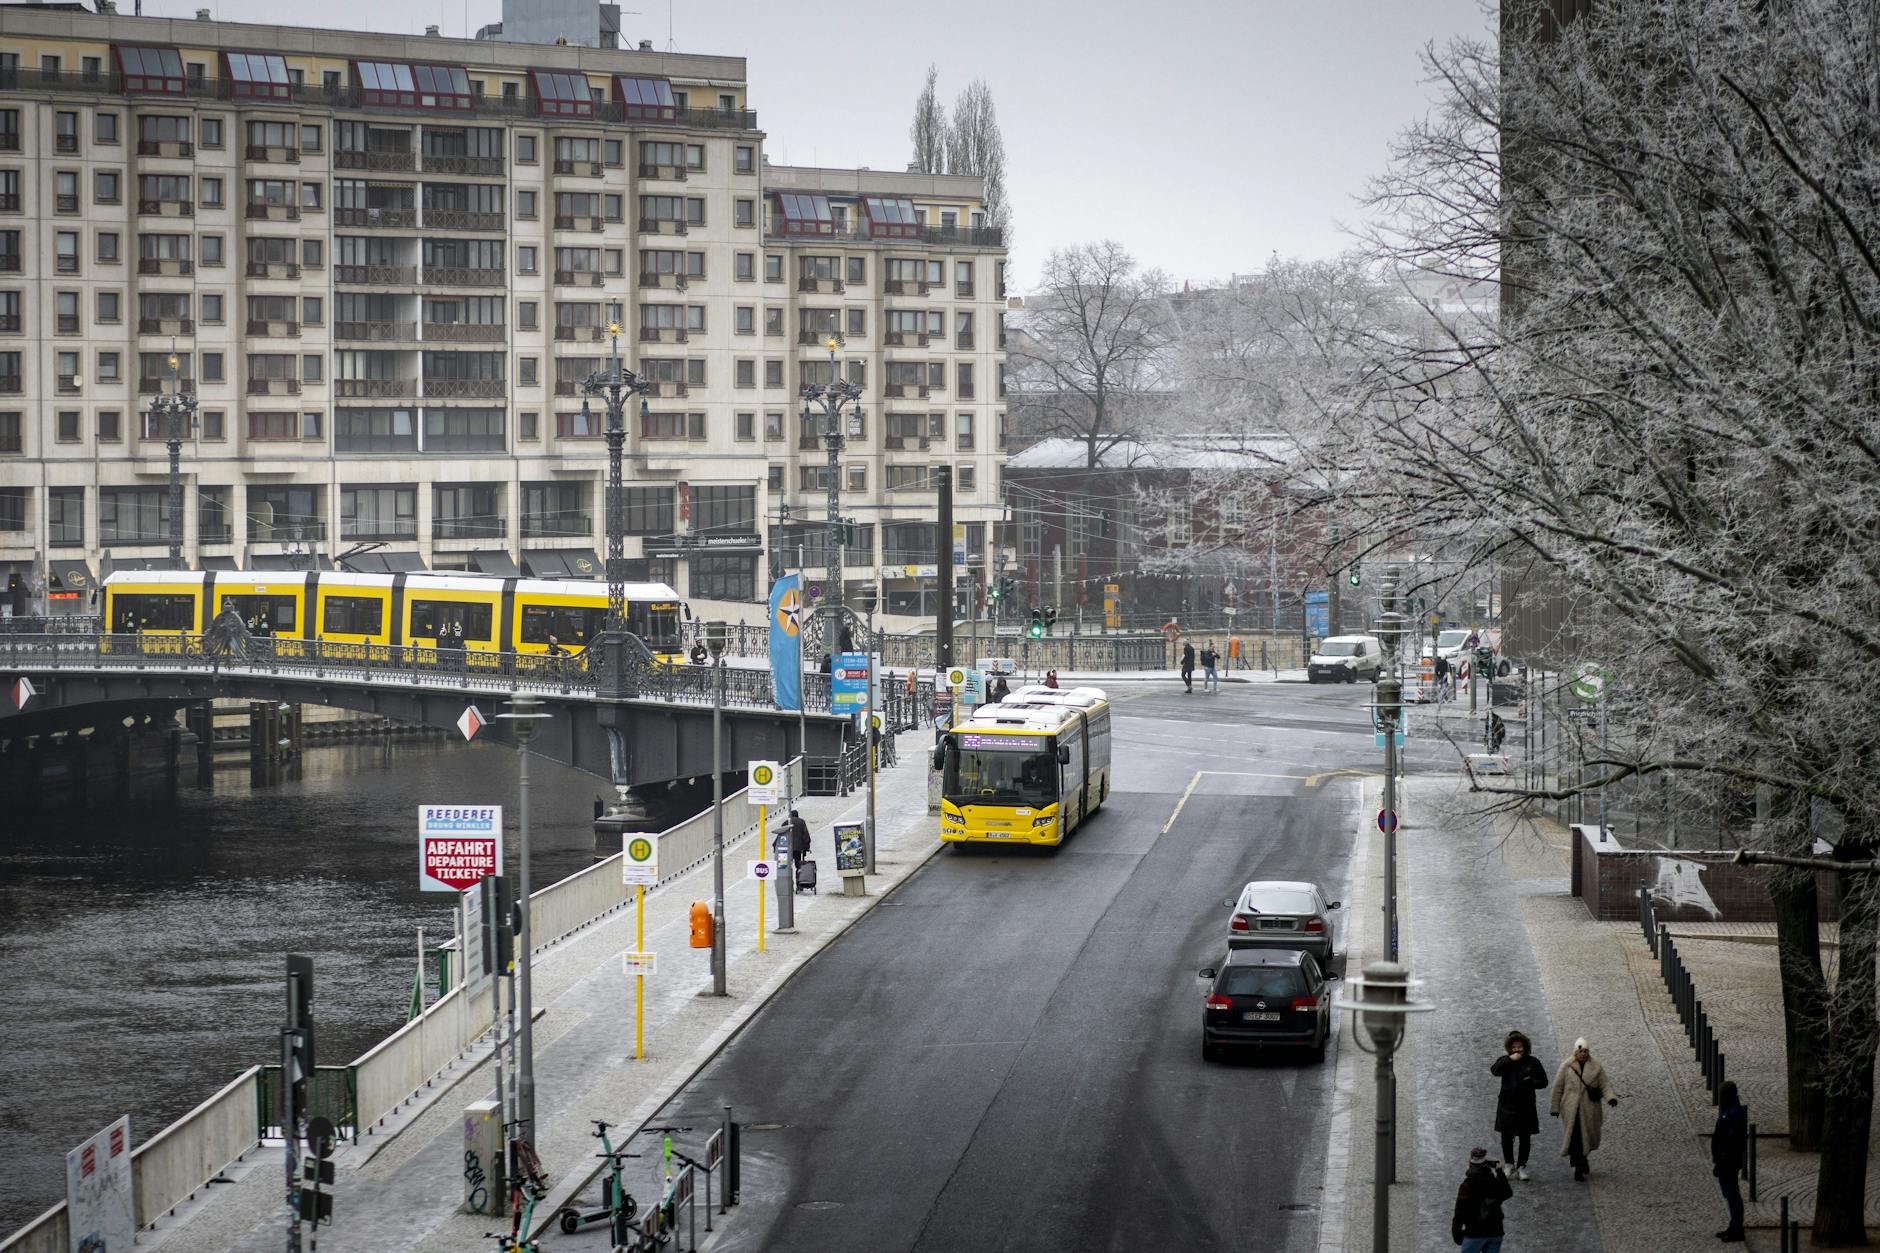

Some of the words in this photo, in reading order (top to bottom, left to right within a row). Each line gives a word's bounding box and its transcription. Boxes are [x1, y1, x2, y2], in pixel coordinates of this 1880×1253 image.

[758, 770, 768, 780] H
[426, 809, 494, 819] REEDEREI
[427, 841, 494, 855] ABFAHRT
[634, 843, 645, 857] H
[428, 856, 494, 867] DEPARTURE
[436, 868, 485, 879] TICKETS
